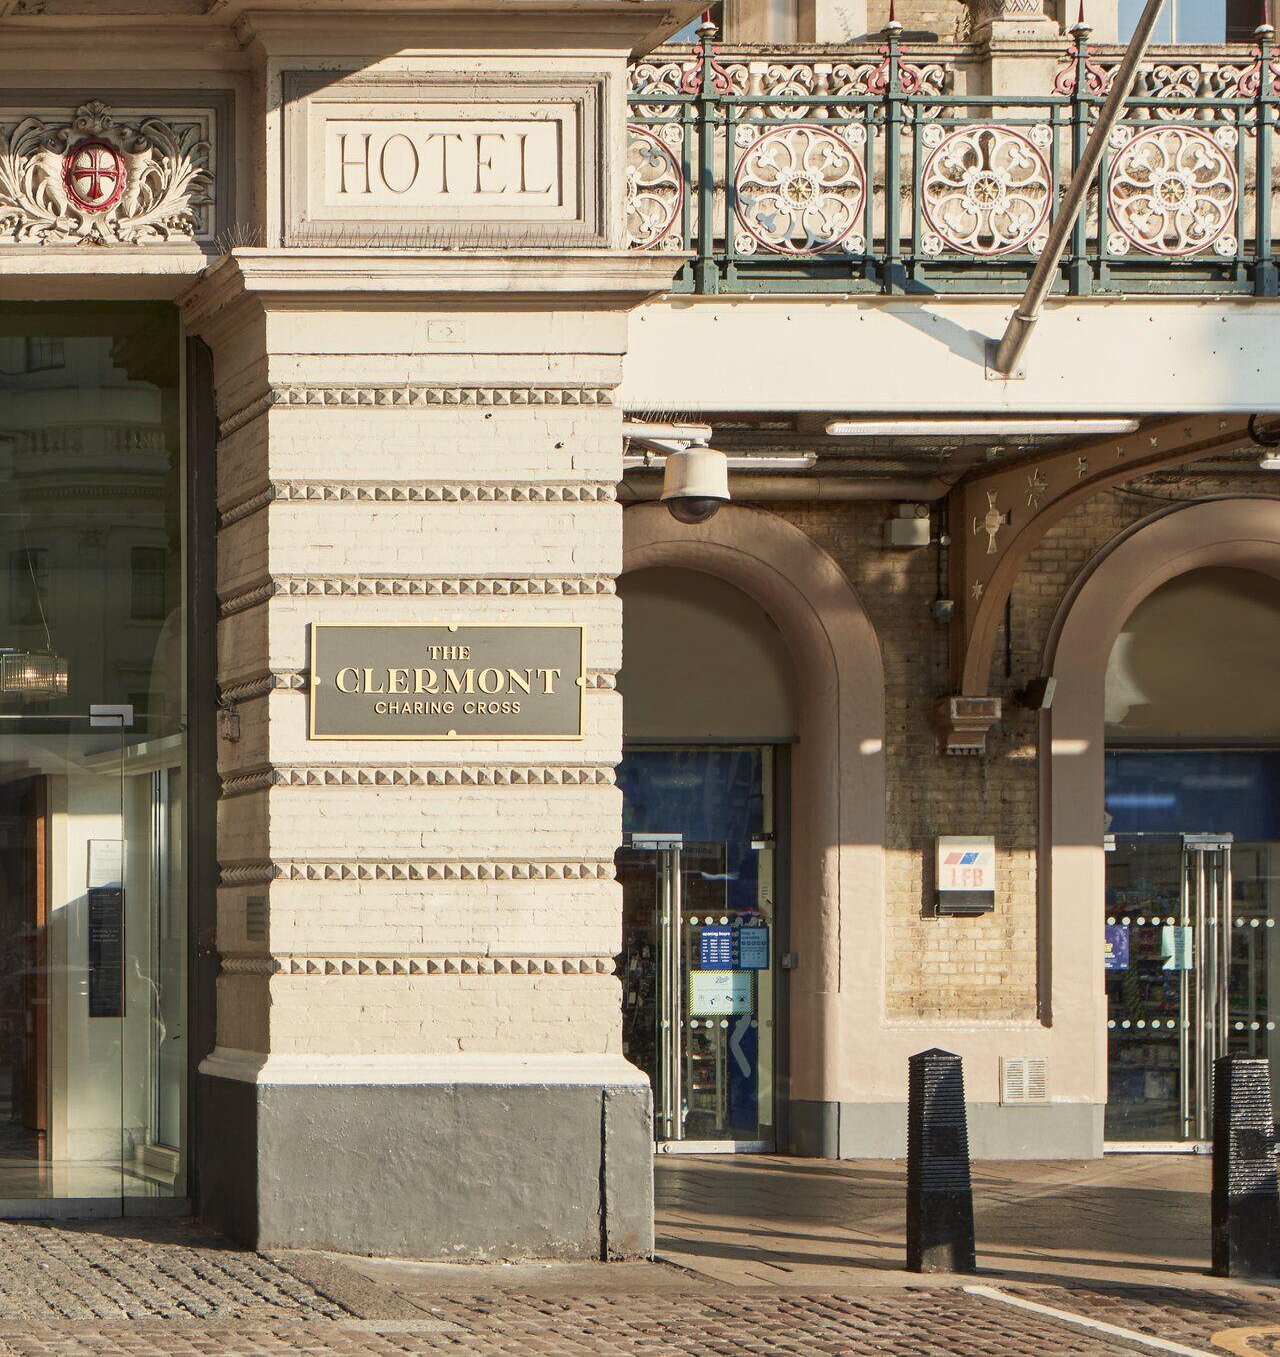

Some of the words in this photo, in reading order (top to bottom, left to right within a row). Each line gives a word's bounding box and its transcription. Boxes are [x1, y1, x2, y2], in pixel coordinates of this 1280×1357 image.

[337, 133, 552, 194] HOTEL
[426, 645, 471, 661] THE
[334, 667, 561, 696] CLERMONT
[374, 701, 455, 715] CHARING
[463, 701, 522, 715] CROSS
